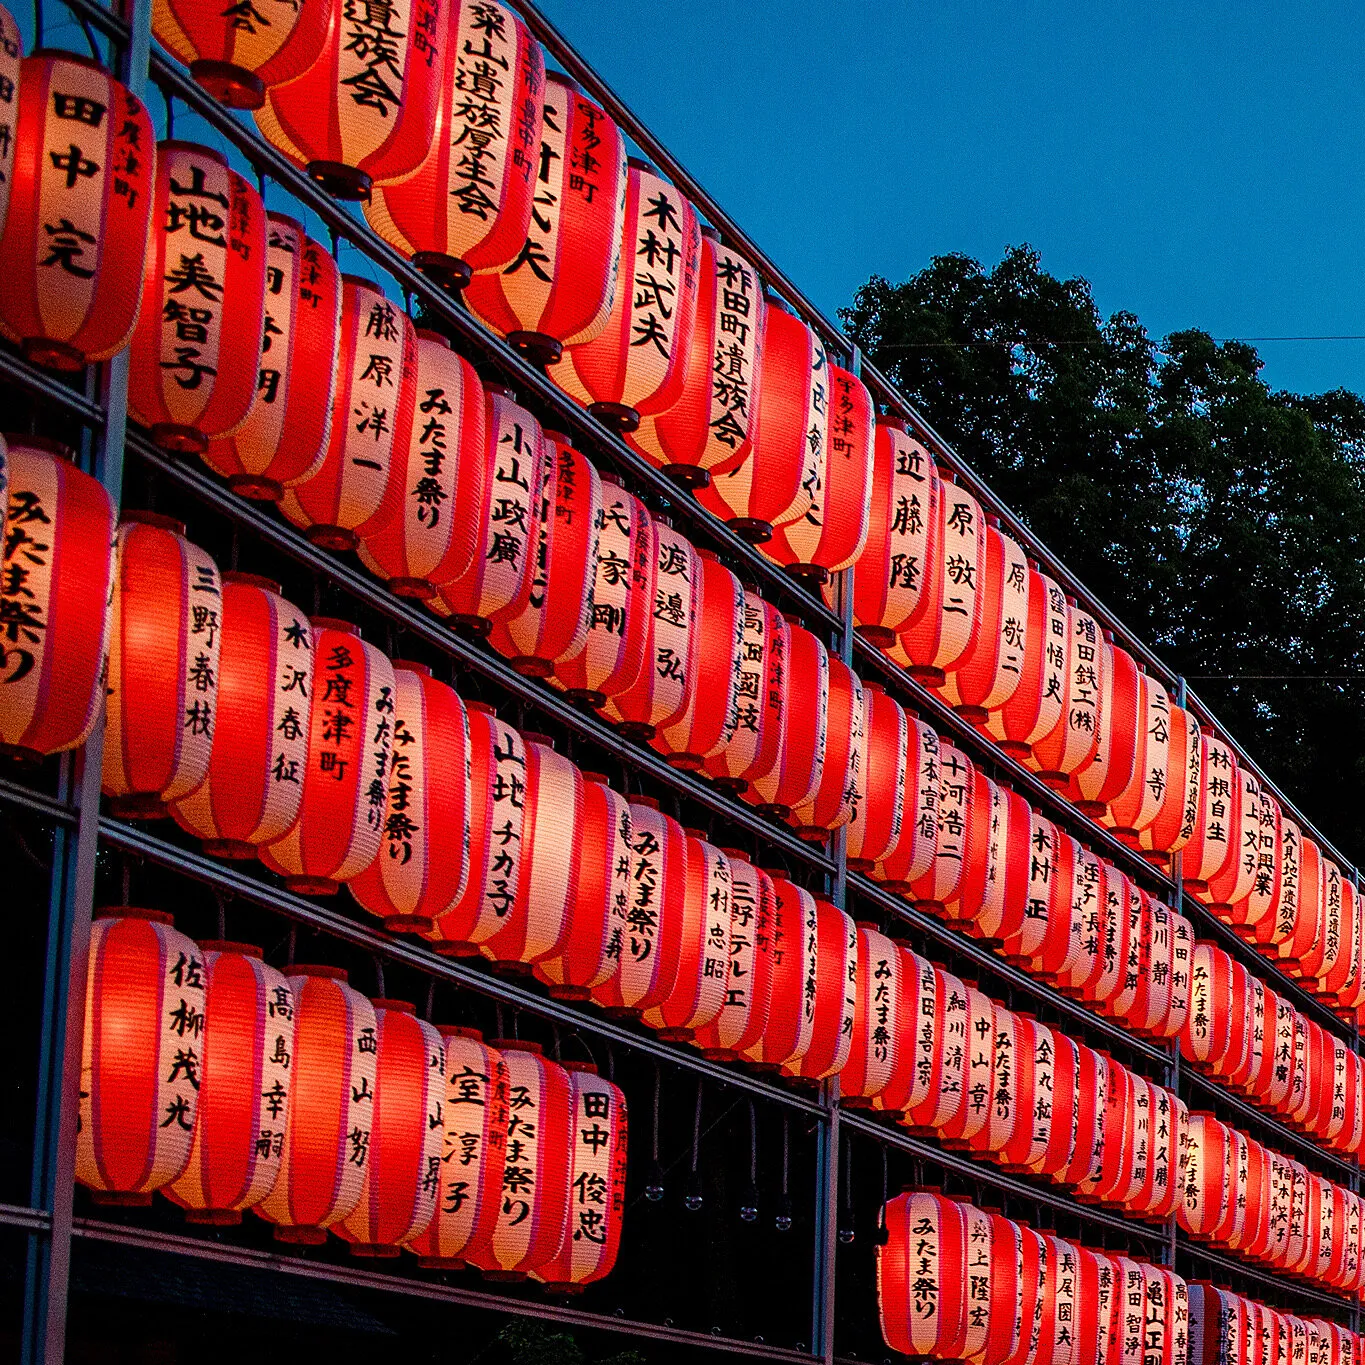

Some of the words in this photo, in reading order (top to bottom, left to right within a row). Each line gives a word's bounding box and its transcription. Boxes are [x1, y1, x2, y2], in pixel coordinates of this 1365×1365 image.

[39, 92, 108, 279] 田中完
[568, 101, 606, 203] 宇多津町
[159, 167, 229, 390] 山地美智子
[630, 190, 683, 359] 木村武夫
[352, 302, 400, 472] 藤原洋一
[833, 376, 857, 459] 宇多津町
[410, 389, 453, 529] みたま祭り
[891, 450, 926, 591] 近藤隆
[944, 504, 976, 616] 原敬二
[1002, 562, 1025, 674] 原敬二
[184, 566, 222, 740] 三野春枝
[319, 646, 355, 781] 多度津町
[365, 686, 395, 832] みたま祭り
[486, 732, 526, 917] 山地チカ子
[627, 831, 660, 963] みたま祭り
[704, 855, 730, 980] 志村忠昭
[804, 910, 818, 1024] みたま祭り
[870, 960, 892, 1063] みたま祭り
[1193, 966, 1210, 1039] みたま祭り
[159, 951, 205, 1132] 佐柳茂光
[969, 1018, 991, 1114] 中山章
[994, 1032, 1012, 1120] みたま祭り
[442, 1066, 490, 1214] 室淳子
[502, 1086, 535, 1227] みたま祭り
[573, 1092, 606, 1245] 田中俊忠
[1186, 1137, 1200, 1210] みたま祭り
[911, 1217, 939, 1320] みたま祭り
